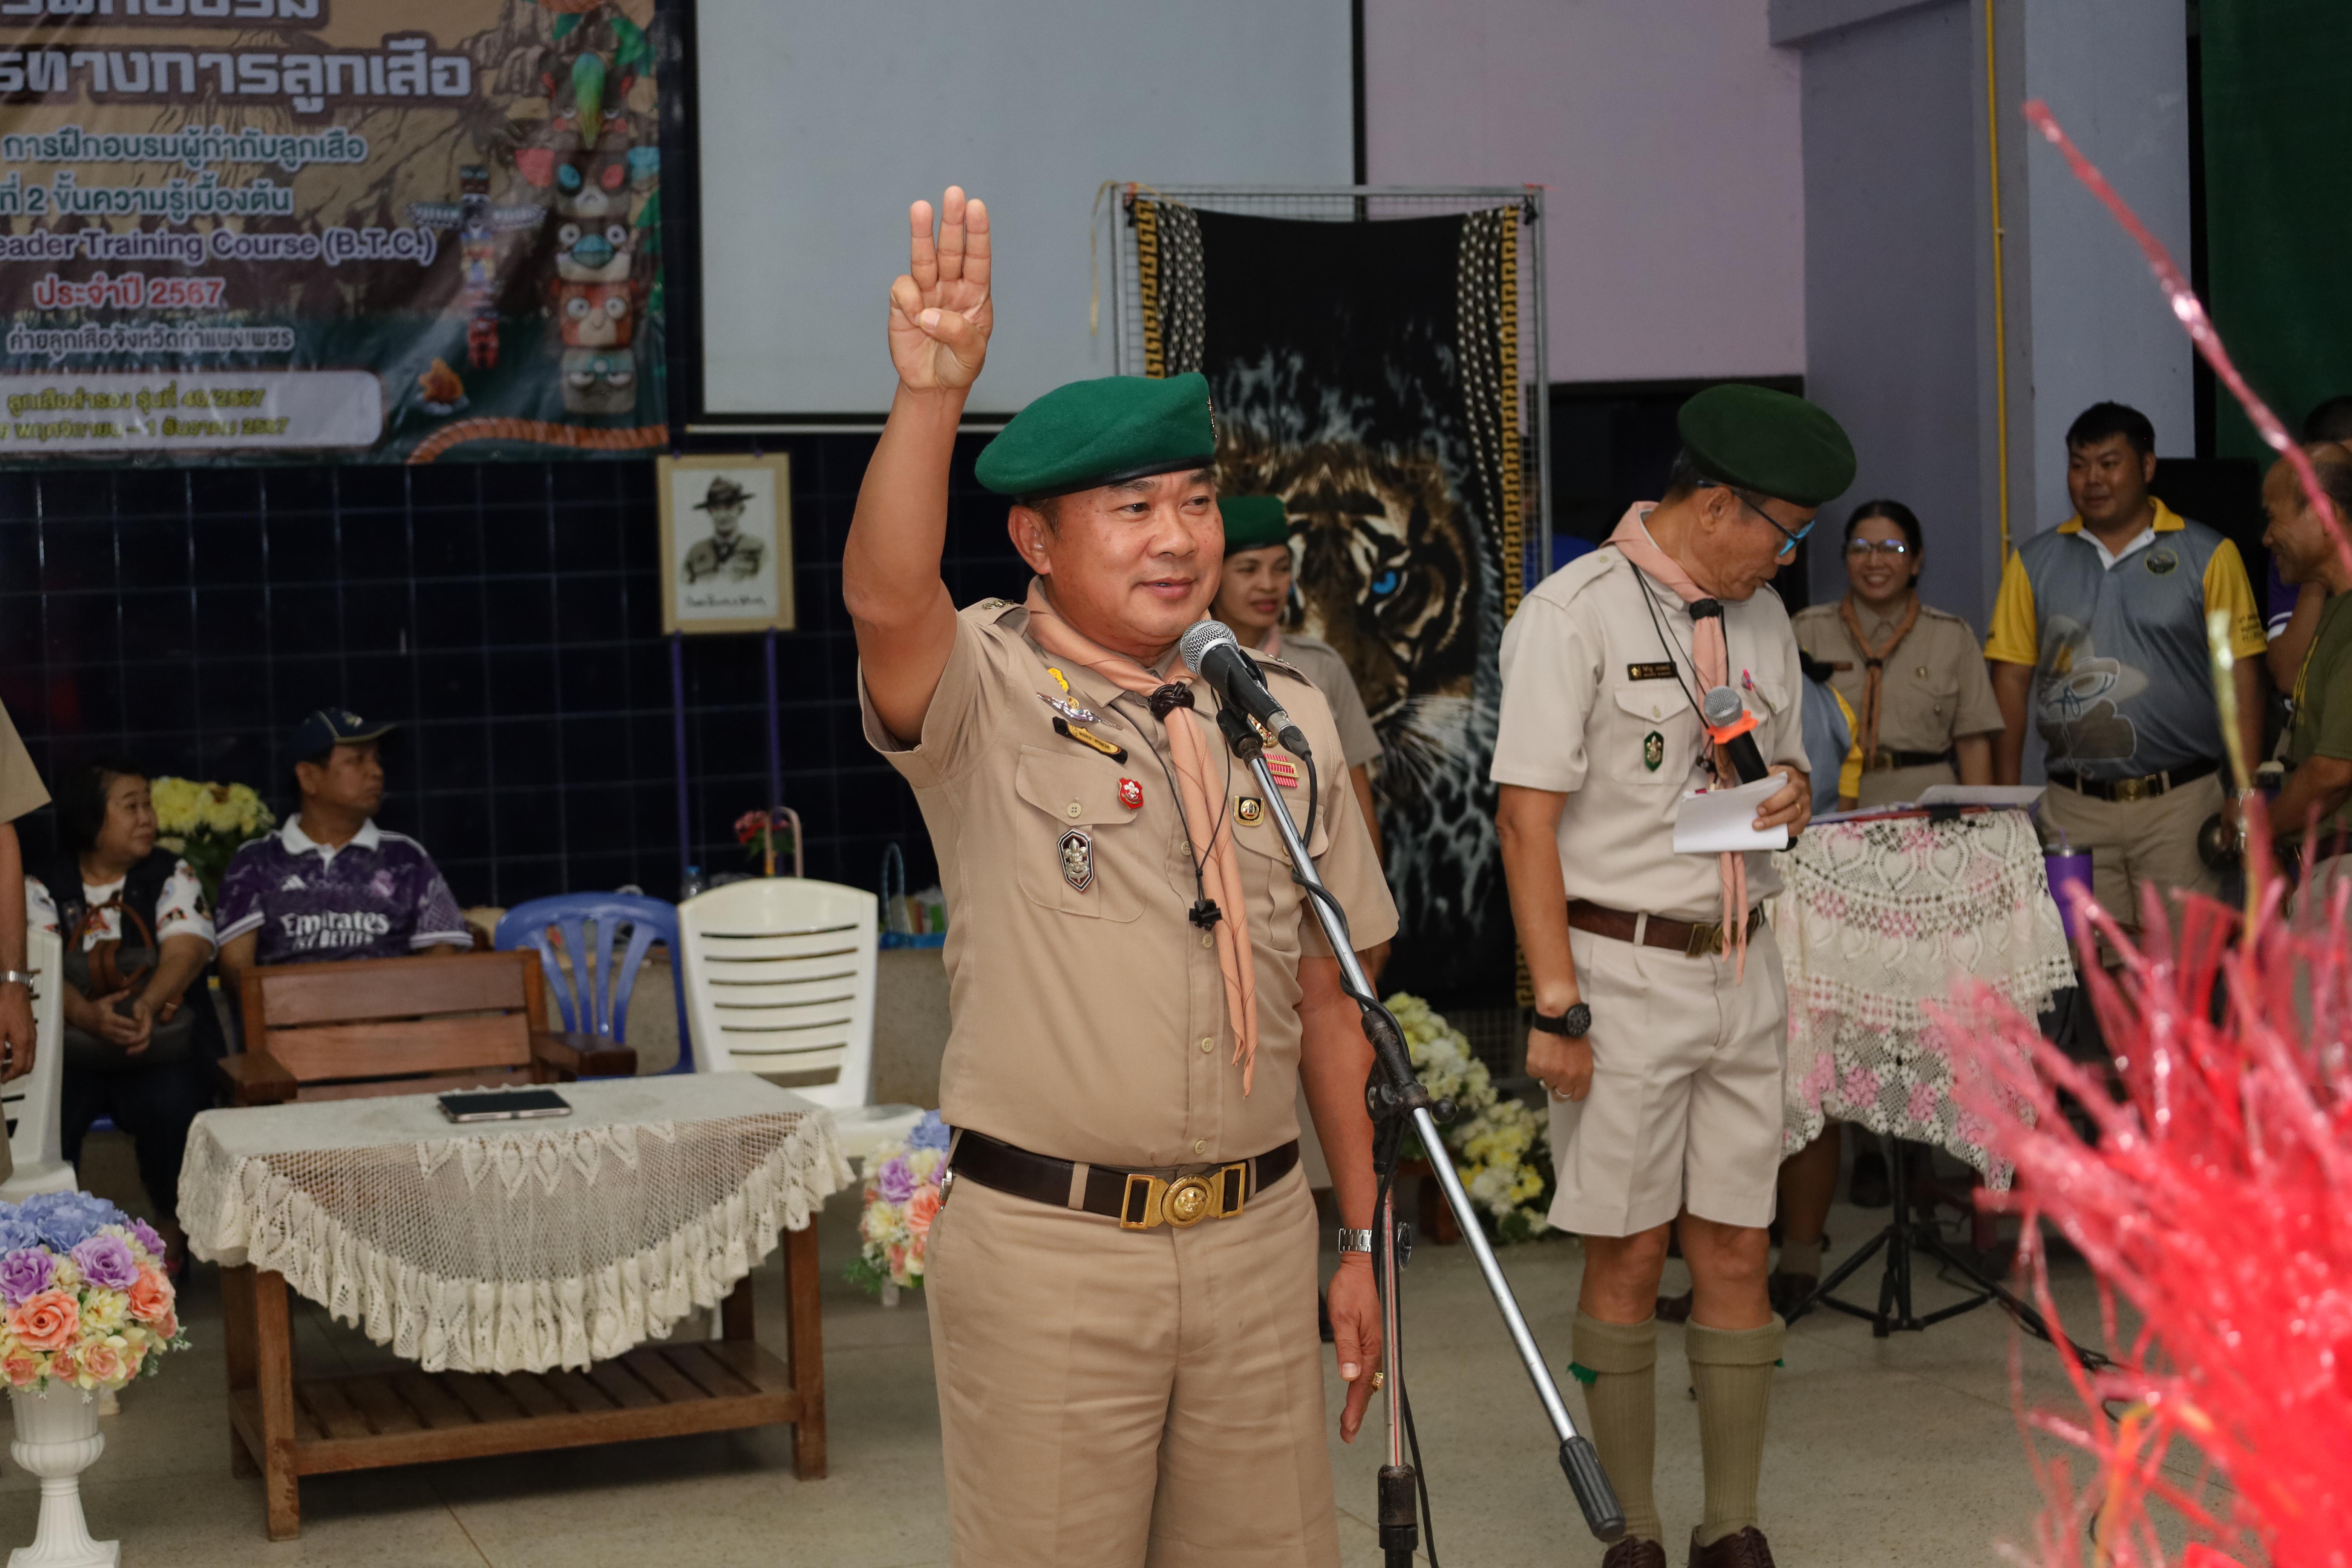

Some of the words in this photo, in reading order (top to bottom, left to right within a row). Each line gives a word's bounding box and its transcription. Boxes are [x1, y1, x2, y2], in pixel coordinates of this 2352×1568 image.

[3, 126, 366, 167] การฝึกอบรมผู้กำกับลูกเสือ
[28, 187, 45, 210] 2
[83, 231, 203, 262] Training
[213, 230, 318, 256] Course
[326, 228, 434, 264] (B.T.C.)
[36, 274, 142, 305] ประจำปี
[151, 280, 223, 305] 2567
[280, 909, 390, 937] Emirates
